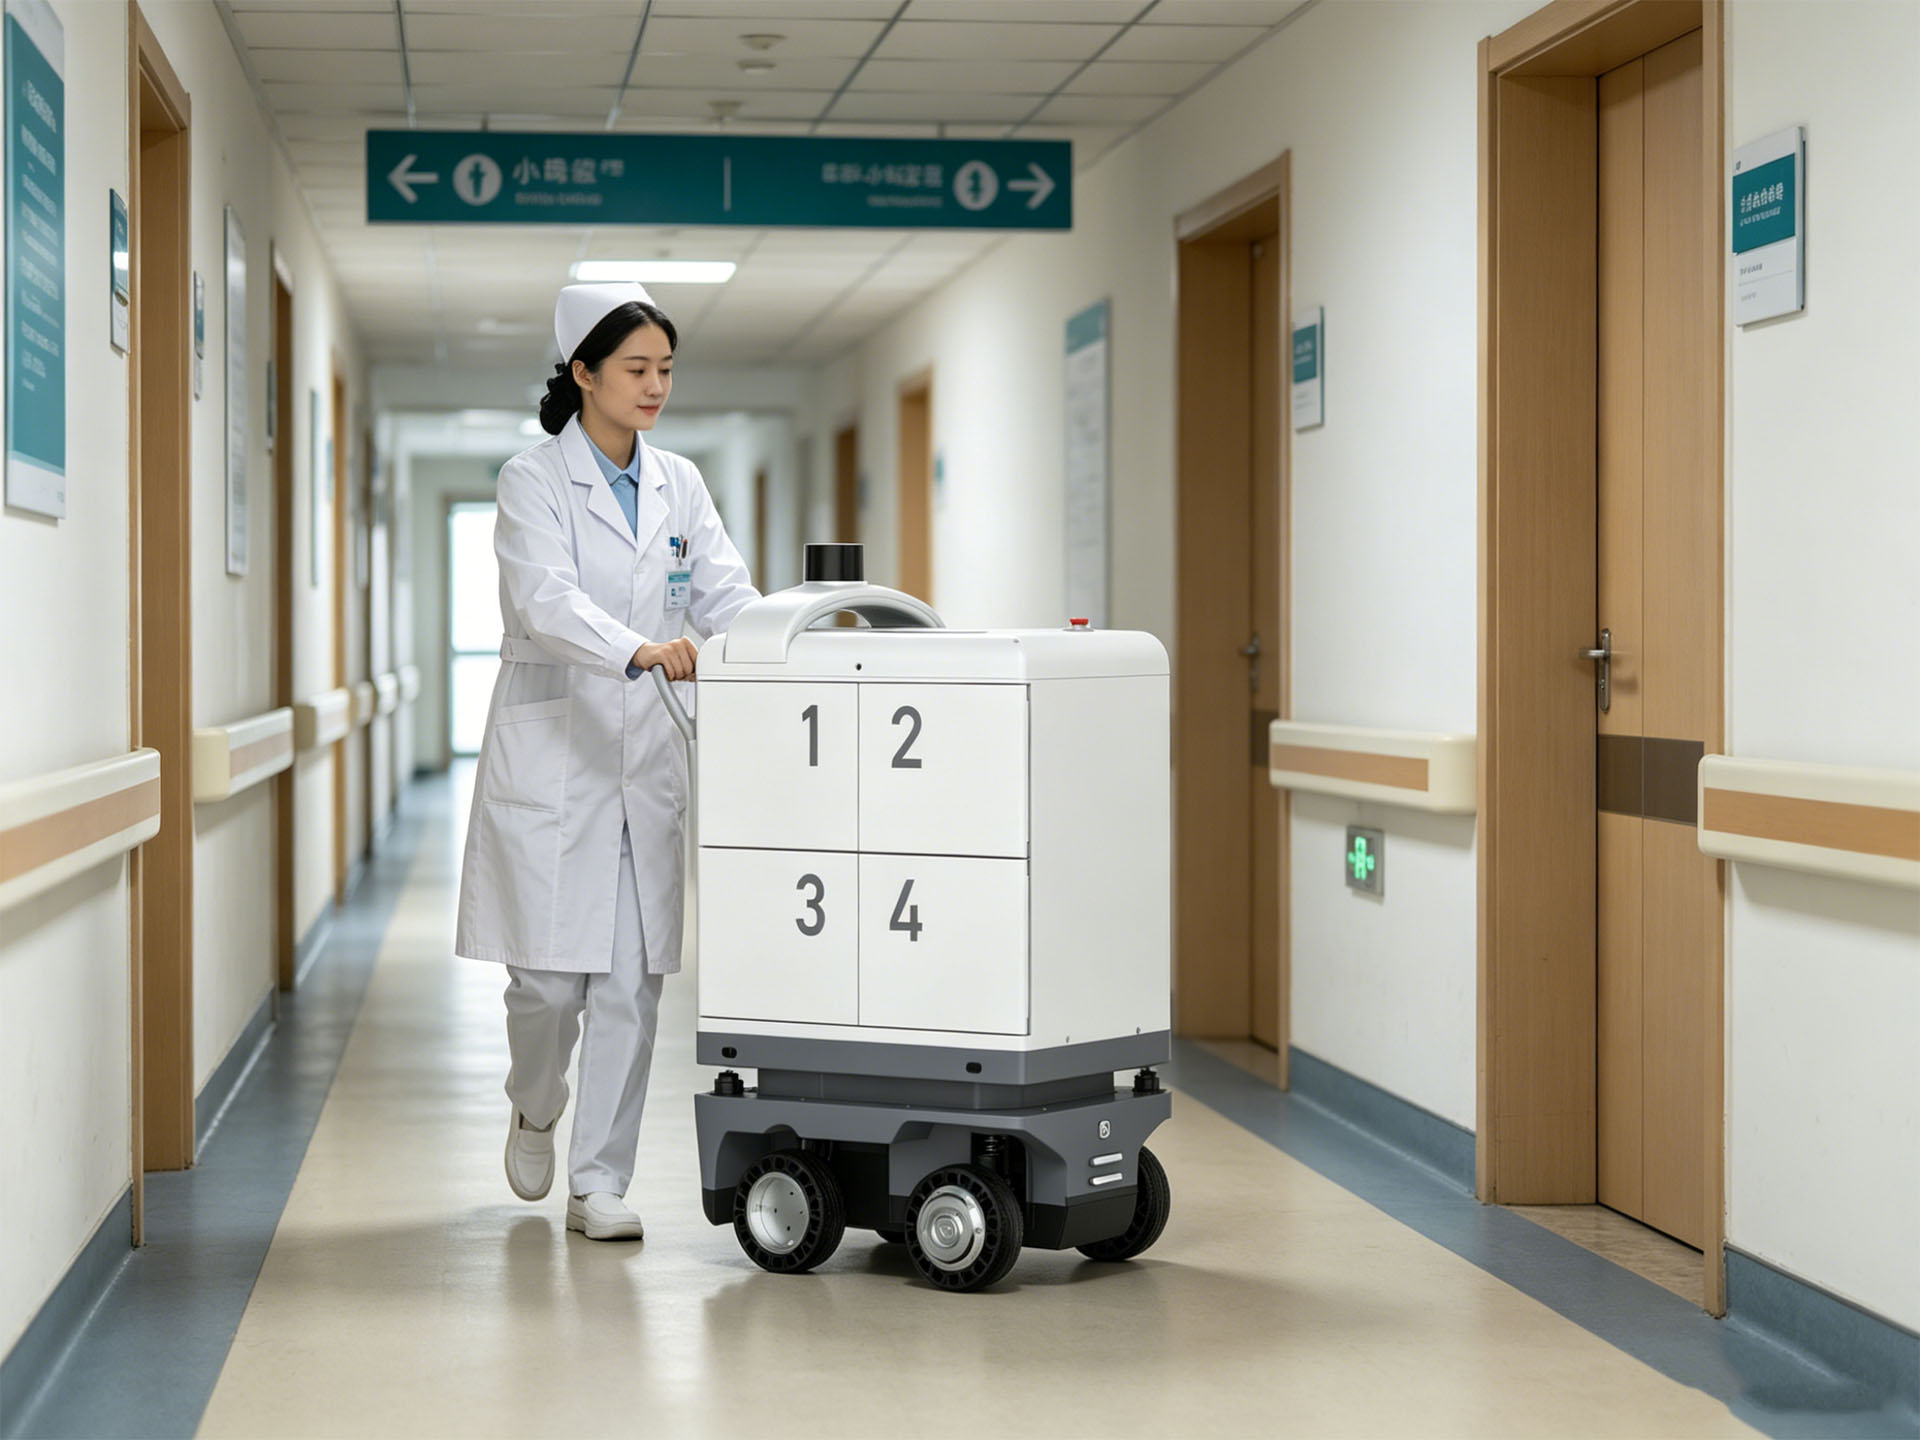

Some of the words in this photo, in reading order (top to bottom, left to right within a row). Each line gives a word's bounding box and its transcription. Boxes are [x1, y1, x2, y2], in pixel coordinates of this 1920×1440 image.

[802, 705, 818, 766] 1
[892, 706, 921, 768] 2
[796, 874, 825, 936] 3
[890, 880, 922, 941] 4
